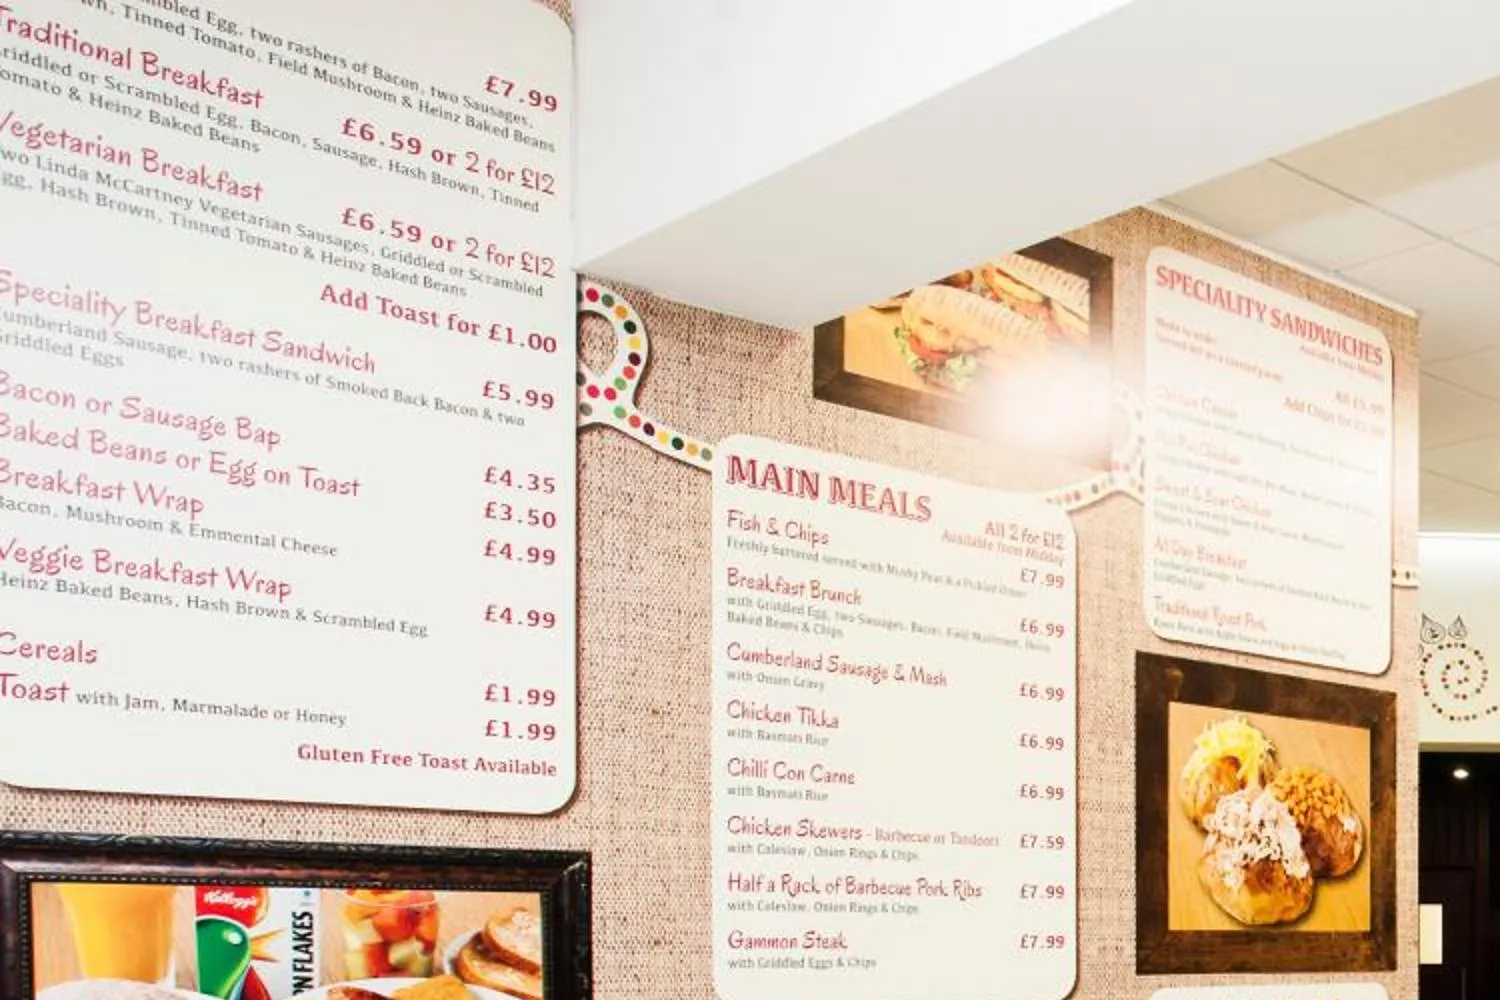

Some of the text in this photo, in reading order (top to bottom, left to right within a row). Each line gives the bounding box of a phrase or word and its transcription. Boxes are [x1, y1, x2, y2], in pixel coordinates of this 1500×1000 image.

[0, 5, 264, 108] raditional Breakfast
[123, 4, 185, 36] Tinned
[268, 52, 308, 76] Field
[313, 67, 396, 103] Mushroom
[402, 97, 414, 109] &
[419, 100, 460, 124] Heinz
[465, 114, 508, 138] Baked
[513, 130, 554, 152] Beans
[485, 75, 558, 112] £7.99
[341, 117, 555, 195] £6.59 or 2 for £12
[141, 148, 264, 201] Breakfast
[341, 207, 555, 278] £6.59 or 2 for £12
[0, 269, 376, 374] Speciality Breakfast Sandwich
[320, 284, 557, 353] Add Toast for £1.00
[1156, 265, 1268, 322] SPECIALITY
[1270, 307, 1383, 366] SANDWICHES
[482, 380, 554, 410] £5.99
[85, 396, 113, 415] or
[120, 396, 226, 441] Sausage
[234, 416, 281, 450] Bap
[88, 429, 167, 465] Beans
[175, 453, 201, 470] or
[208, 451, 258, 487] Egg
[264, 469, 291, 485] on
[298, 466, 360, 497] Toast
[484, 465, 555, 494] £4.35
[133, 480, 205, 520] Wrap
[726, 454, 931, 522] MAIN MEALS
[484, 501, 556, 529] £3.50
[727, 509, 829, 548] Fish & Chips
[483, 539, 556, 566] £4.99
[94, 549, 218, 588] Breakfast
[225, 566, 292, 603] Wrap
[727, 567, 862, 605] Breakfast Brunch
[1020, 568, 1064, 588] £7.99
[56, 578, 113, 599] Baked
[187, 595, 230, 613] Hash
[235, 601, 291, 620] Brown
[295, 608, 307, 621] &
[313, 610, 395, 633] Scrambled
[399, 621, 428, 638] Egg
[484, 604, 556, 629] £4.99
[1020, 618, 1064, 638] £6.99
[0, 631, 98, 664] Cereals
[727, 641, 823, 671] Cumberland
[827, 655, 888, 684] Sausage
[909, 665, 947, 686] Mash
[0, 673, 70, 703] Toast
[76, 690, 119, 707] with
[172, 698, 268, 719] Marmalade
[273, 709, 291, 720] or
[296, 709, 347, 728] Honey
[484, 683, 556, 707] £1.99
[1019, 683, 1064, 701] £6.99
[485, 719, 557, 742] £1.99
[727, 700, 840, 728] Chicken Tikka
[1019, 733, 1064, 750] £6.99
[297, 744, 557, 777] Gluten Free Toast Available
[727, 757, 855, 785] Chilli Con Carne
[1020, 784, 1064, 800] £6.99
[727, 815, 862, 840] Chicken Skewers
[1020, 834, 1064, 849] £7.59
[728, 871, 982, 901] Half a Rack of Barbecue Pork Ribs
[1020, 884, 1064, 899] £7.99
[728, 930, 848, 949] Gammon Steak
[1020, 934, 1064, 949] £7.99
